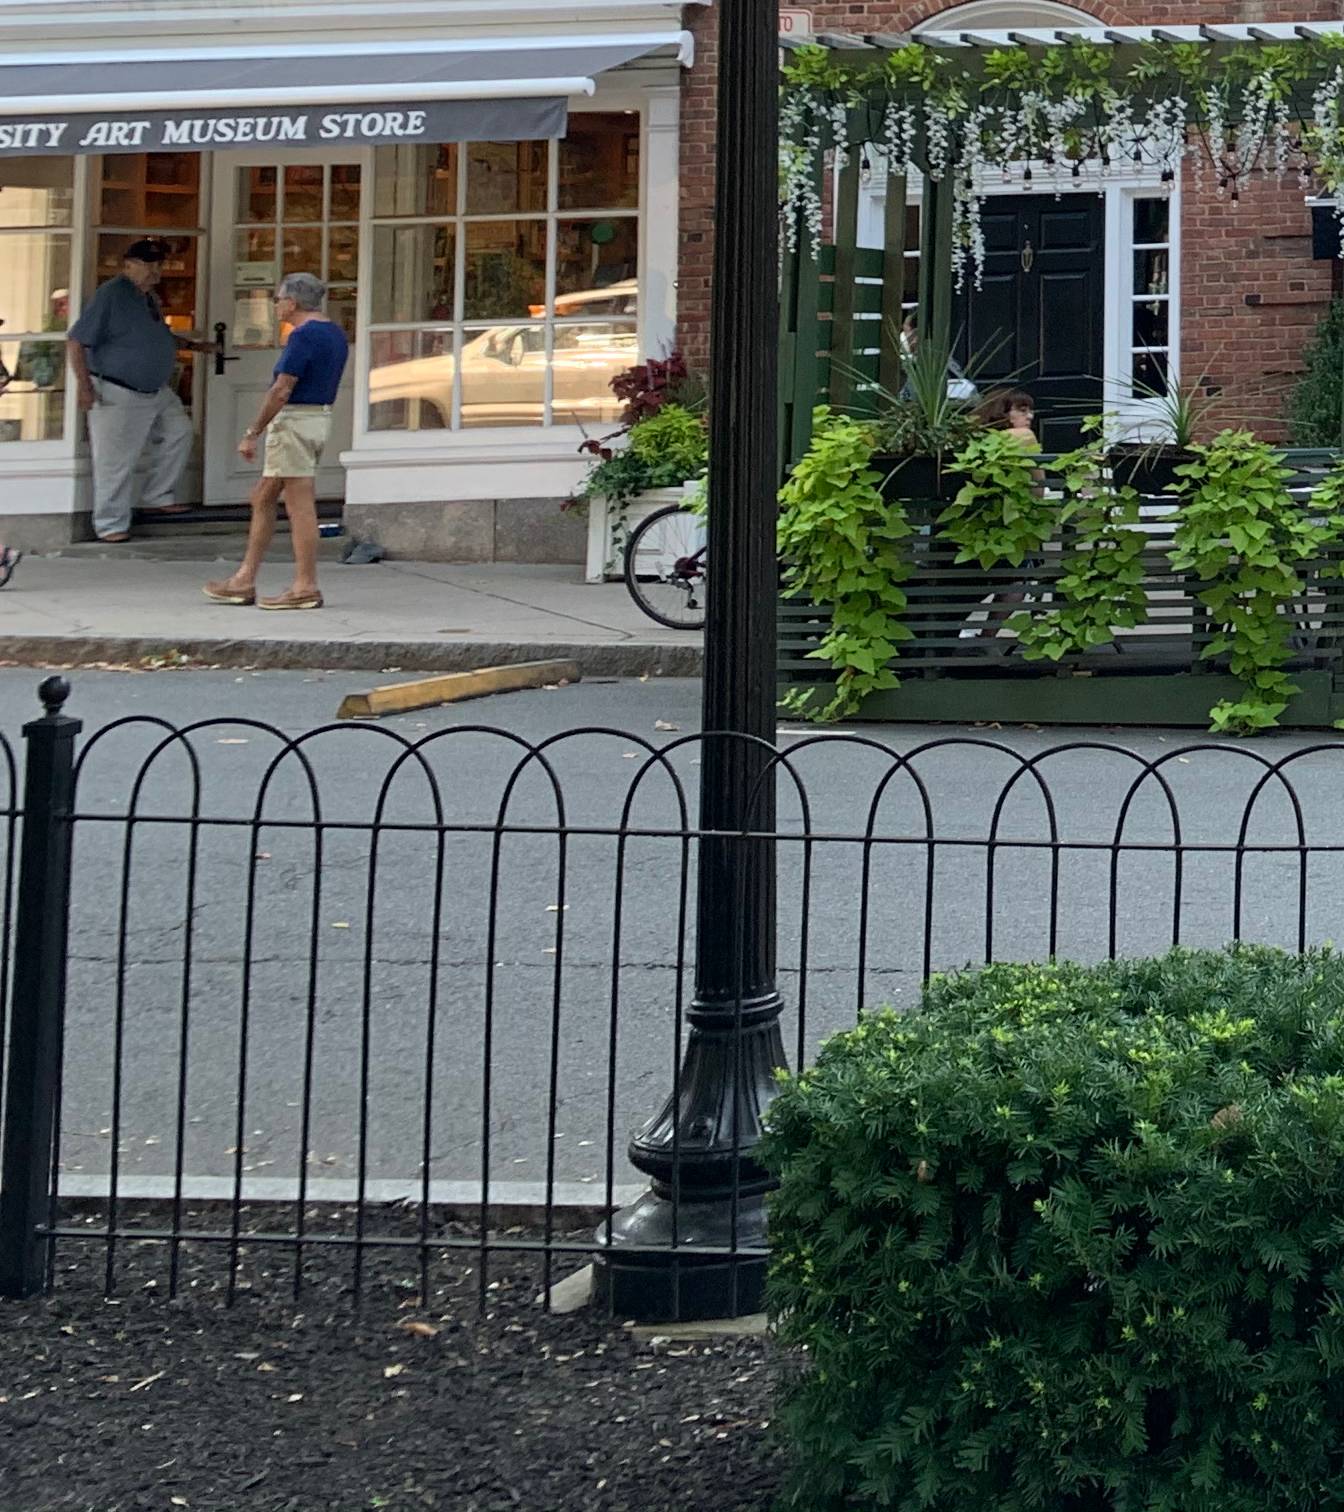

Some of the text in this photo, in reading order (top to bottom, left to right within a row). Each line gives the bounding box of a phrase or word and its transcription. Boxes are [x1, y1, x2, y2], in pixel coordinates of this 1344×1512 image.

[78, 120, 151, 146] ART
[161, 116, 308, 145] MUSEUM
[319, 111, 426, 138] STORE
